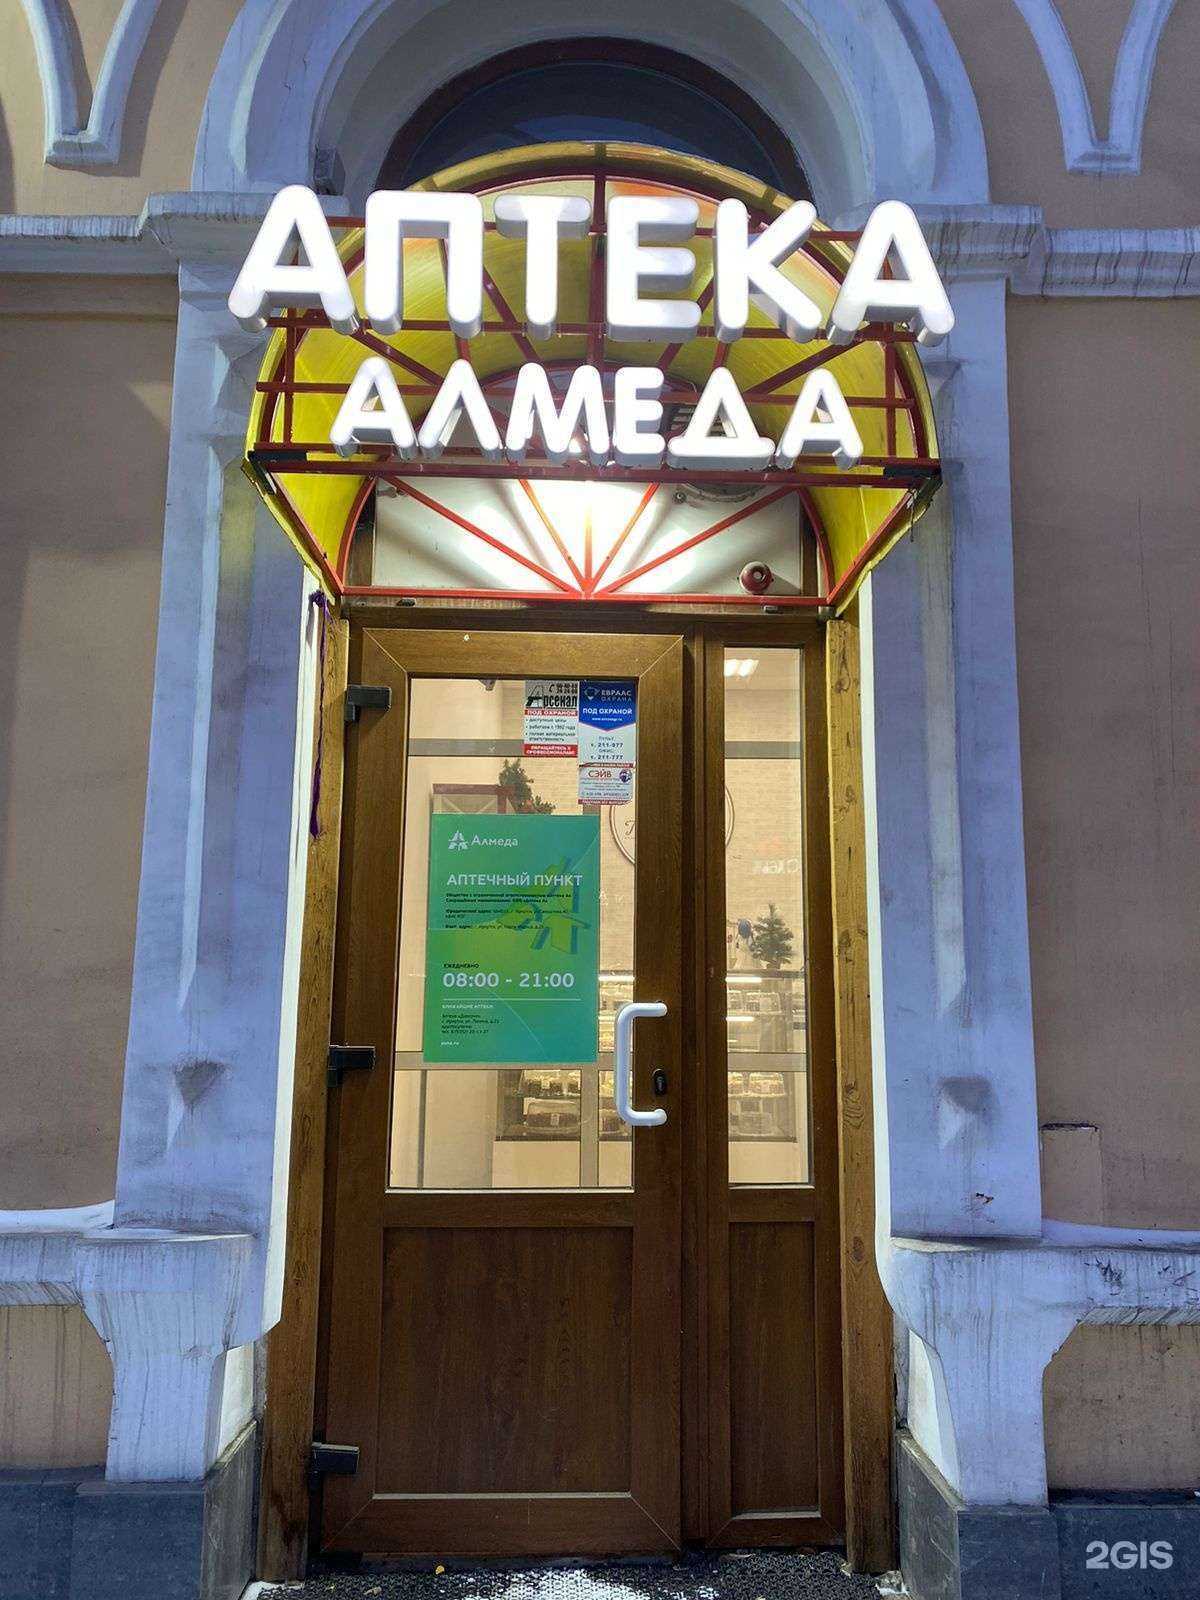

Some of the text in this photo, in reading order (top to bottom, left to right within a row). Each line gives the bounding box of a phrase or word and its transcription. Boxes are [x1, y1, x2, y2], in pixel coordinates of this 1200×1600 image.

[228, 184, 955, 344] АПТЕКА
[329, 356, 864, 470] АЛМЕДА
[582, 707, 633, 715] ПОД ОХРАНОЙ
[588, 769, 612, 778] СЭЙВ
[470, 834, 519, 848] Алмеда
[446, 871, 583, 886] АПТЕЧНЫЙ ПУНКТ
[442, 972, 500, 988] 08:00
[519, 972, 575, 988] 21:00
